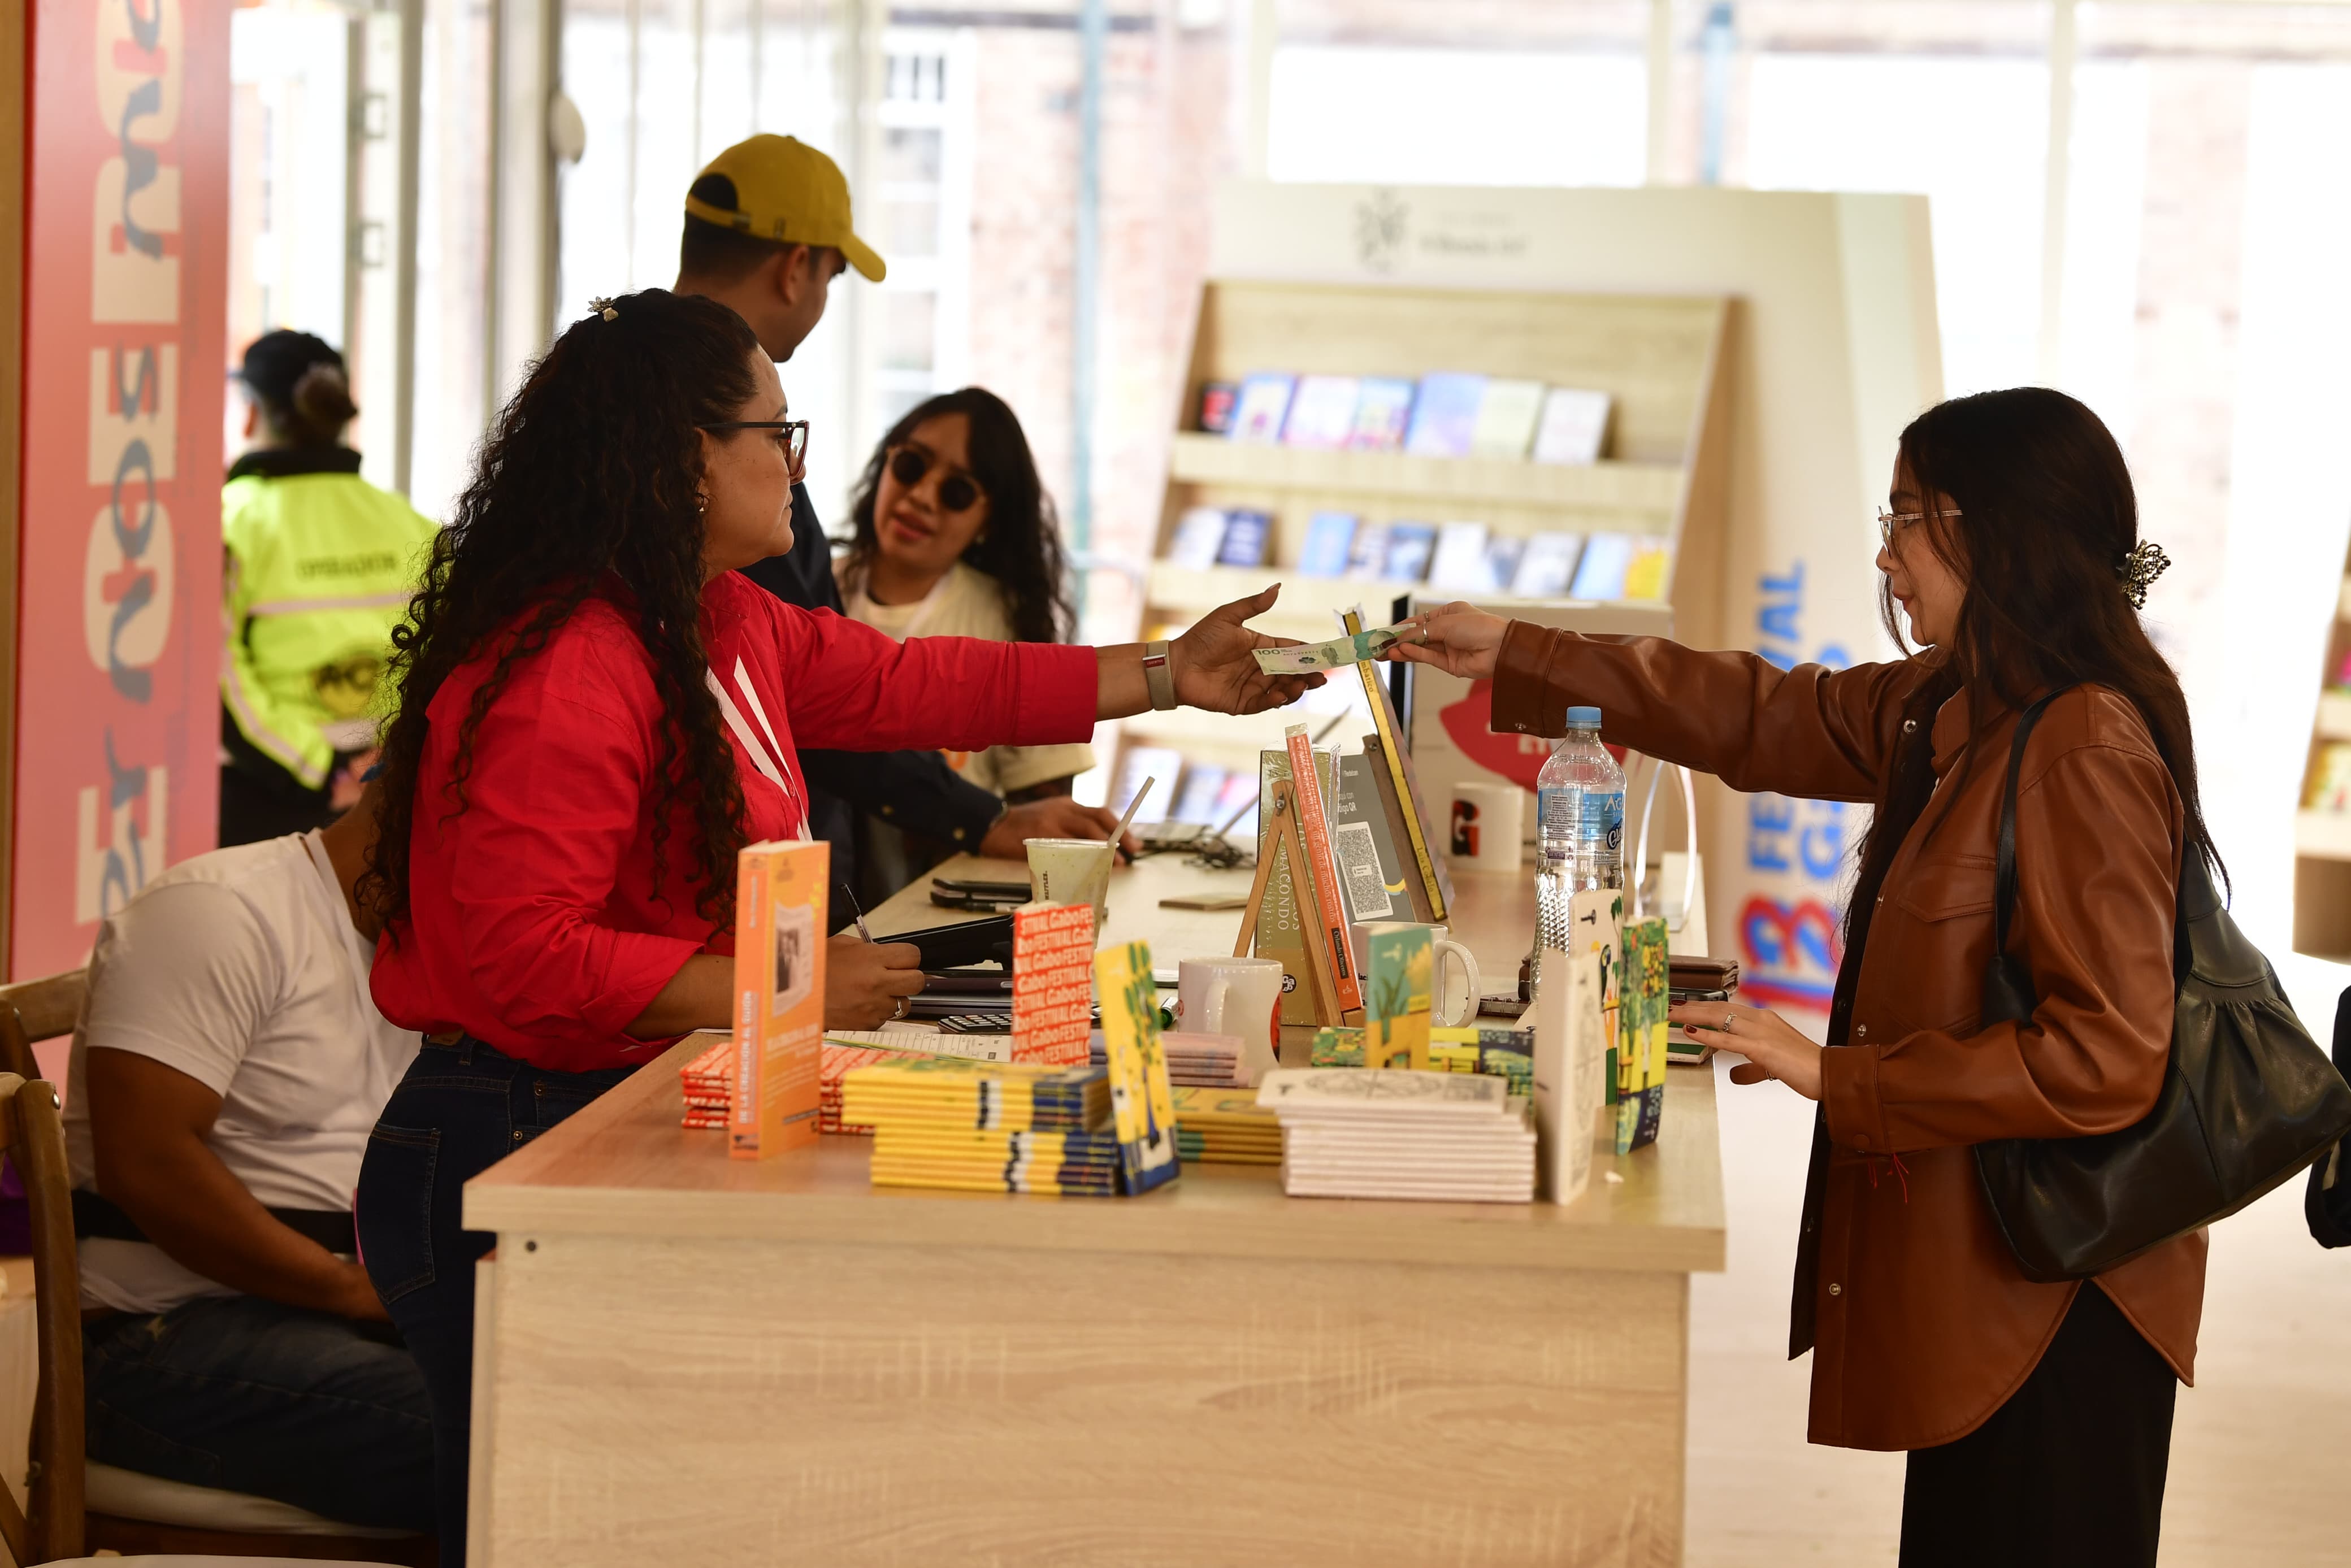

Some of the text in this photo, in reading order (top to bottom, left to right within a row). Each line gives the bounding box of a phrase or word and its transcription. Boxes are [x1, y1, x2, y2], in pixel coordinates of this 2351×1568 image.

[1349, 802, 1357, 811] QR
[1315, 840, 1324, 859] genio
[1318, 859, 1325, 870] de
[1278, 849, 1291, 931] MACONDO
[1321, 870, 1331, 897] muchos
[1326, 898, 1335, 923] rostros
[1333, 930, 1347, 977] Orlando Oliveros
